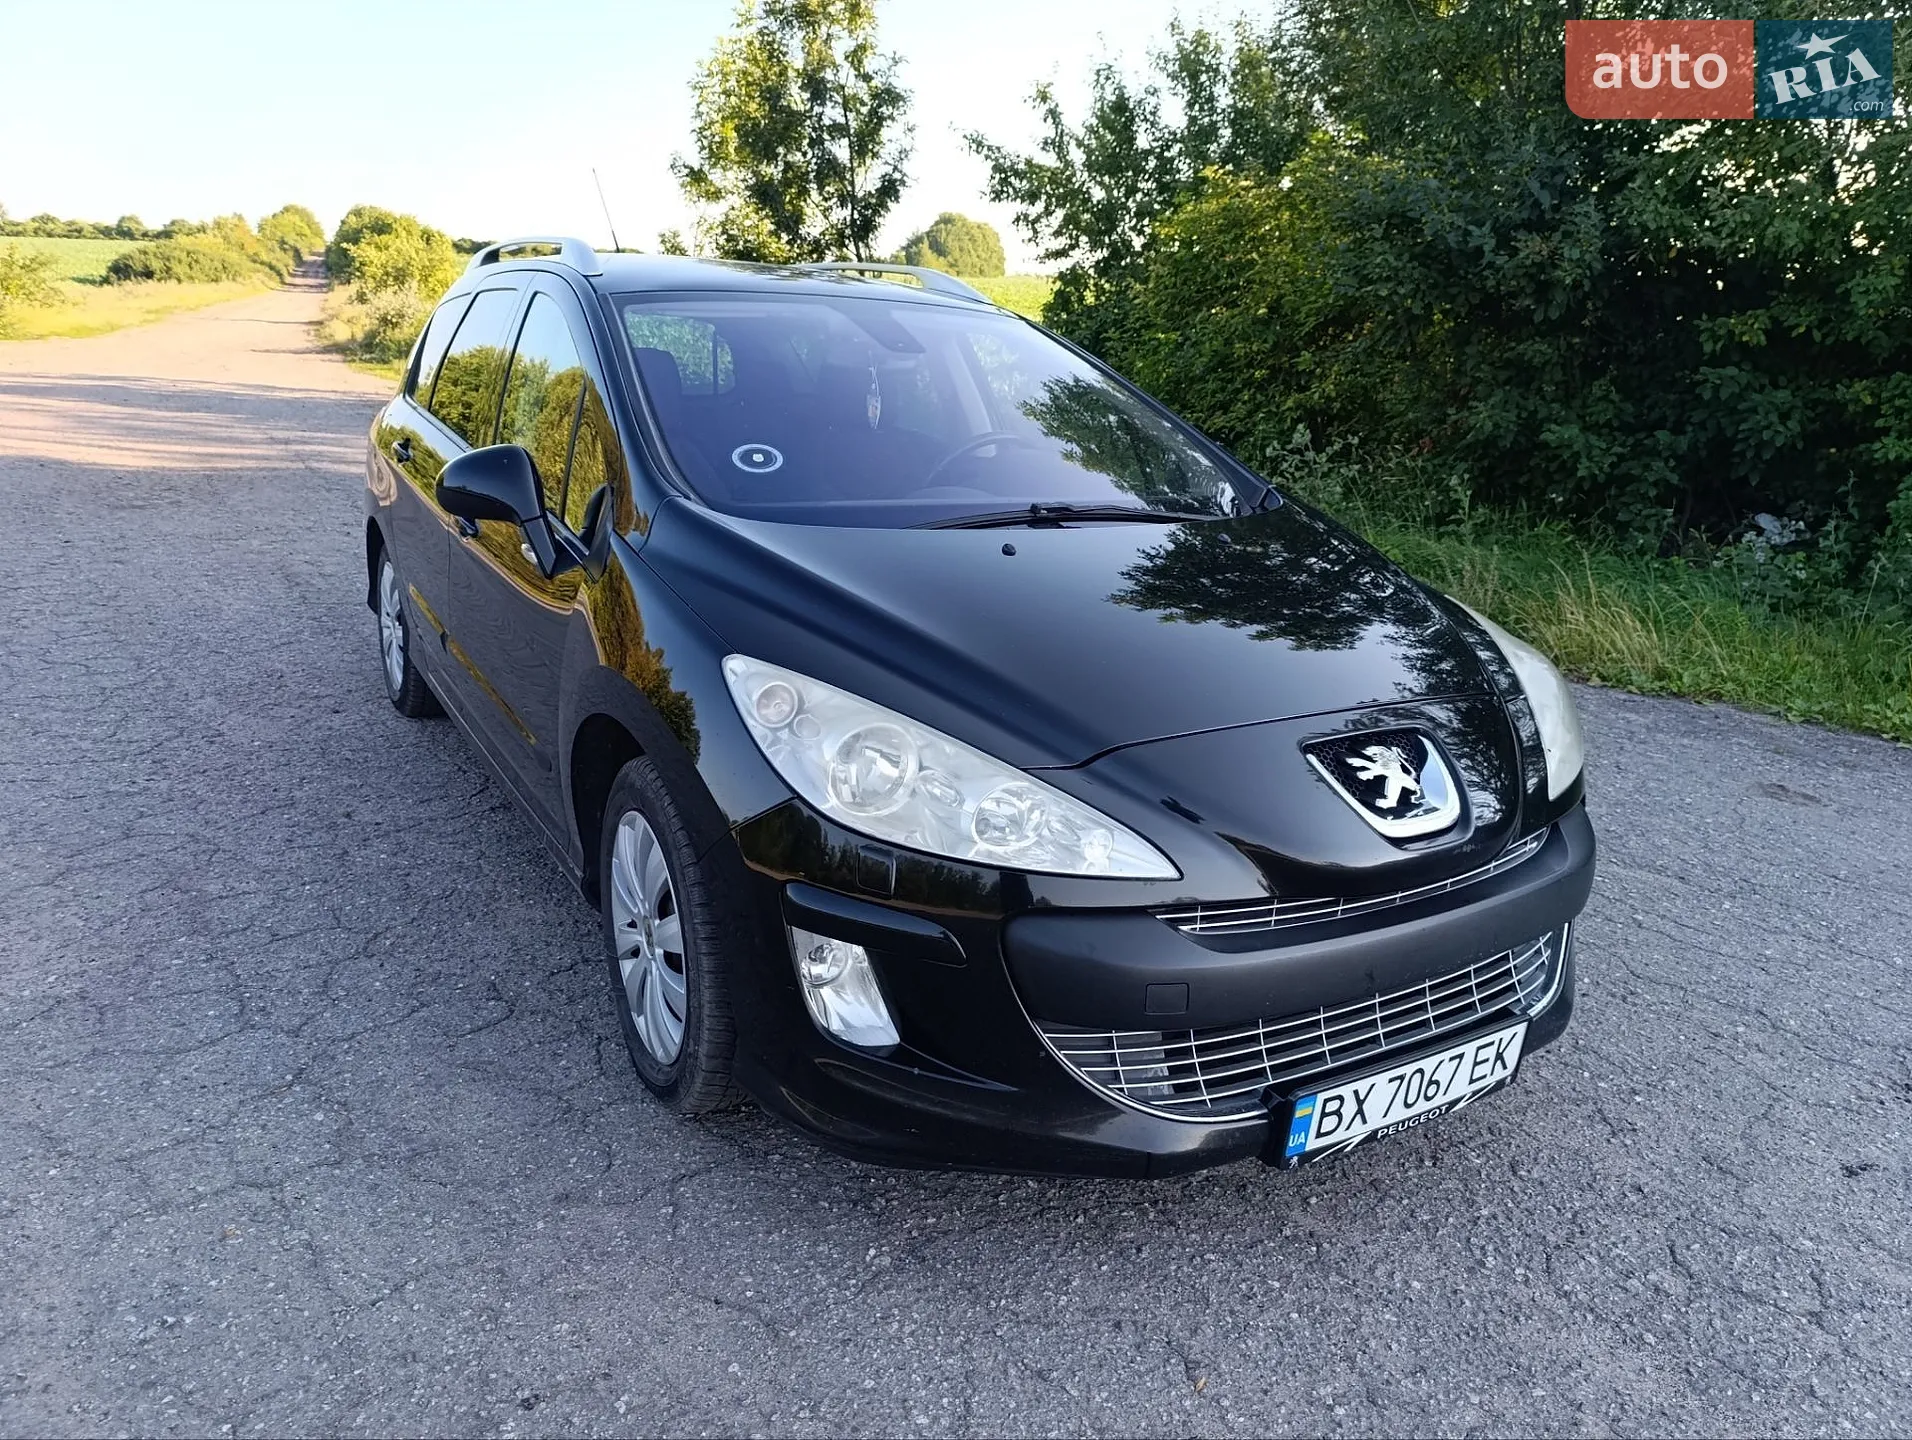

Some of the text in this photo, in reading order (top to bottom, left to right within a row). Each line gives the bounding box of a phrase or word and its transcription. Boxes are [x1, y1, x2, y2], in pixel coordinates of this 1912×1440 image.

[1315, 1031, 1519, 1139] BX 7067 EK
[1377, 1105, 1449, 1139] PEUGEOT
[1288, 1132, 1306, 1147] UA
